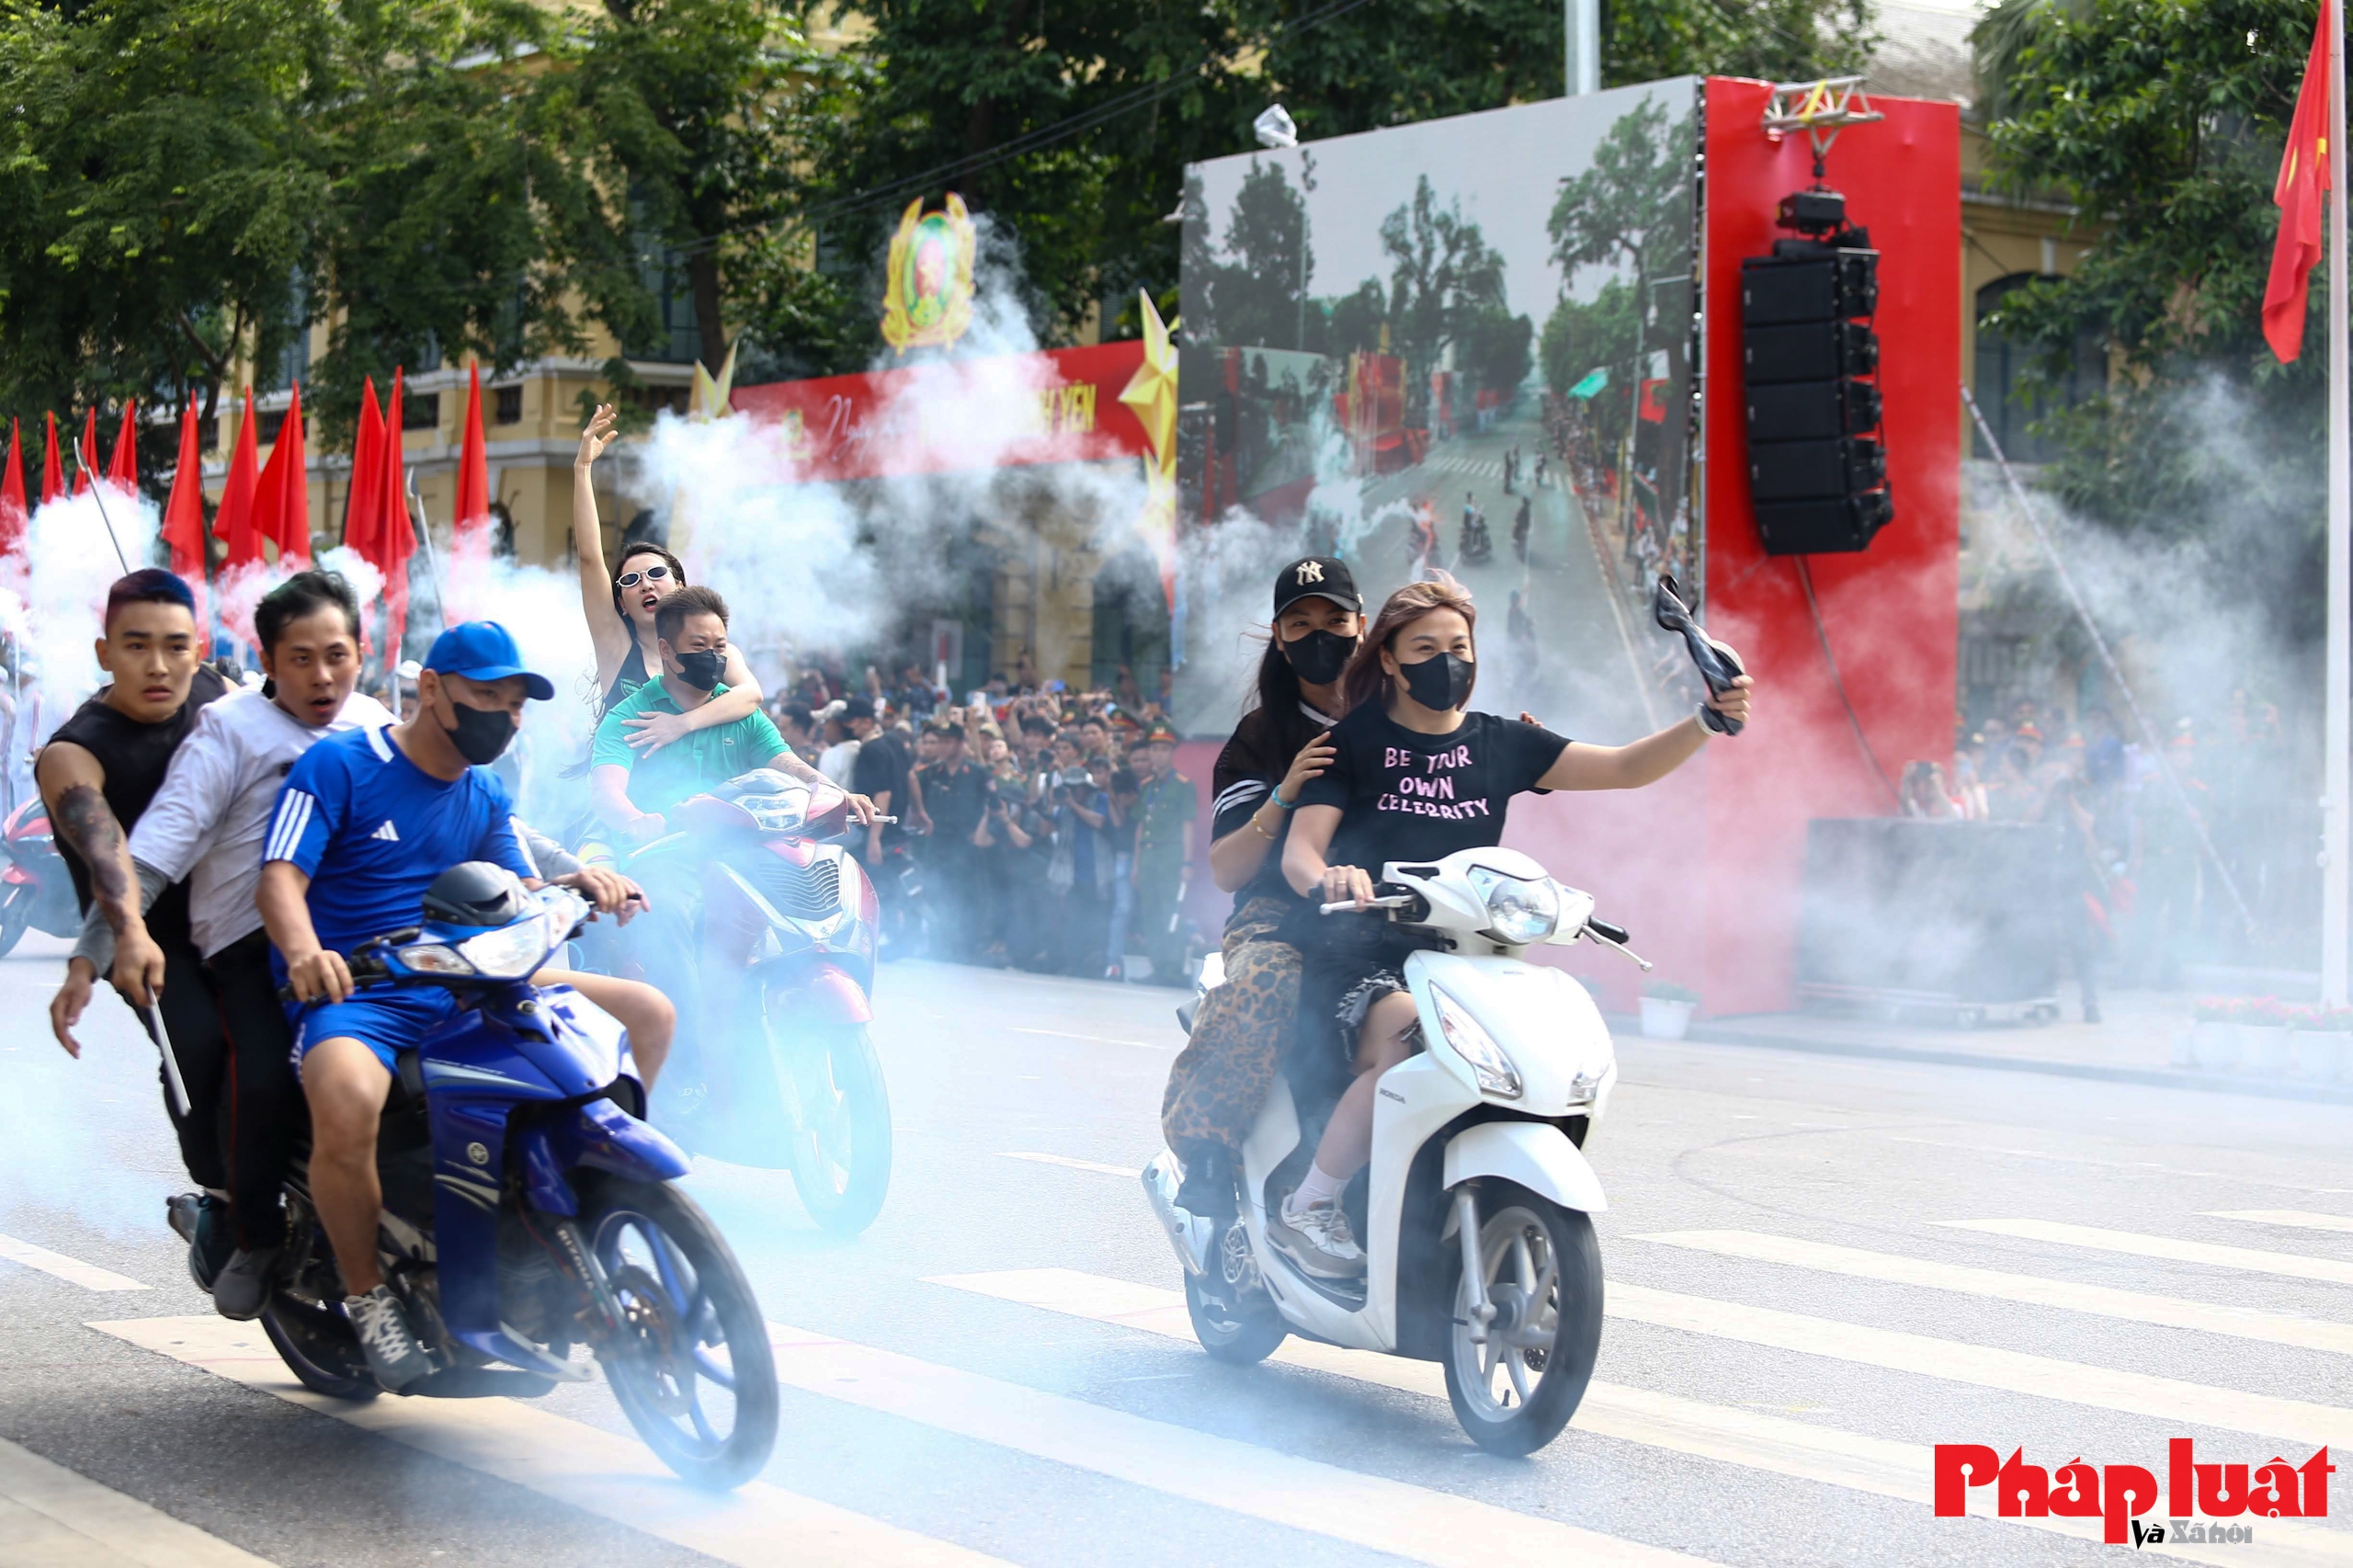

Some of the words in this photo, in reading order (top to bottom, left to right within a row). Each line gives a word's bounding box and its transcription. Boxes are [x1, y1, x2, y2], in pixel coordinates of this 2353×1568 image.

[1296, 561, 1325, 586] NY
[1384, 746, 1412, 768] BE
[1399, 776, 1455, 800] OWN
[1377, 792, 1490, 820] CELEBRITY
